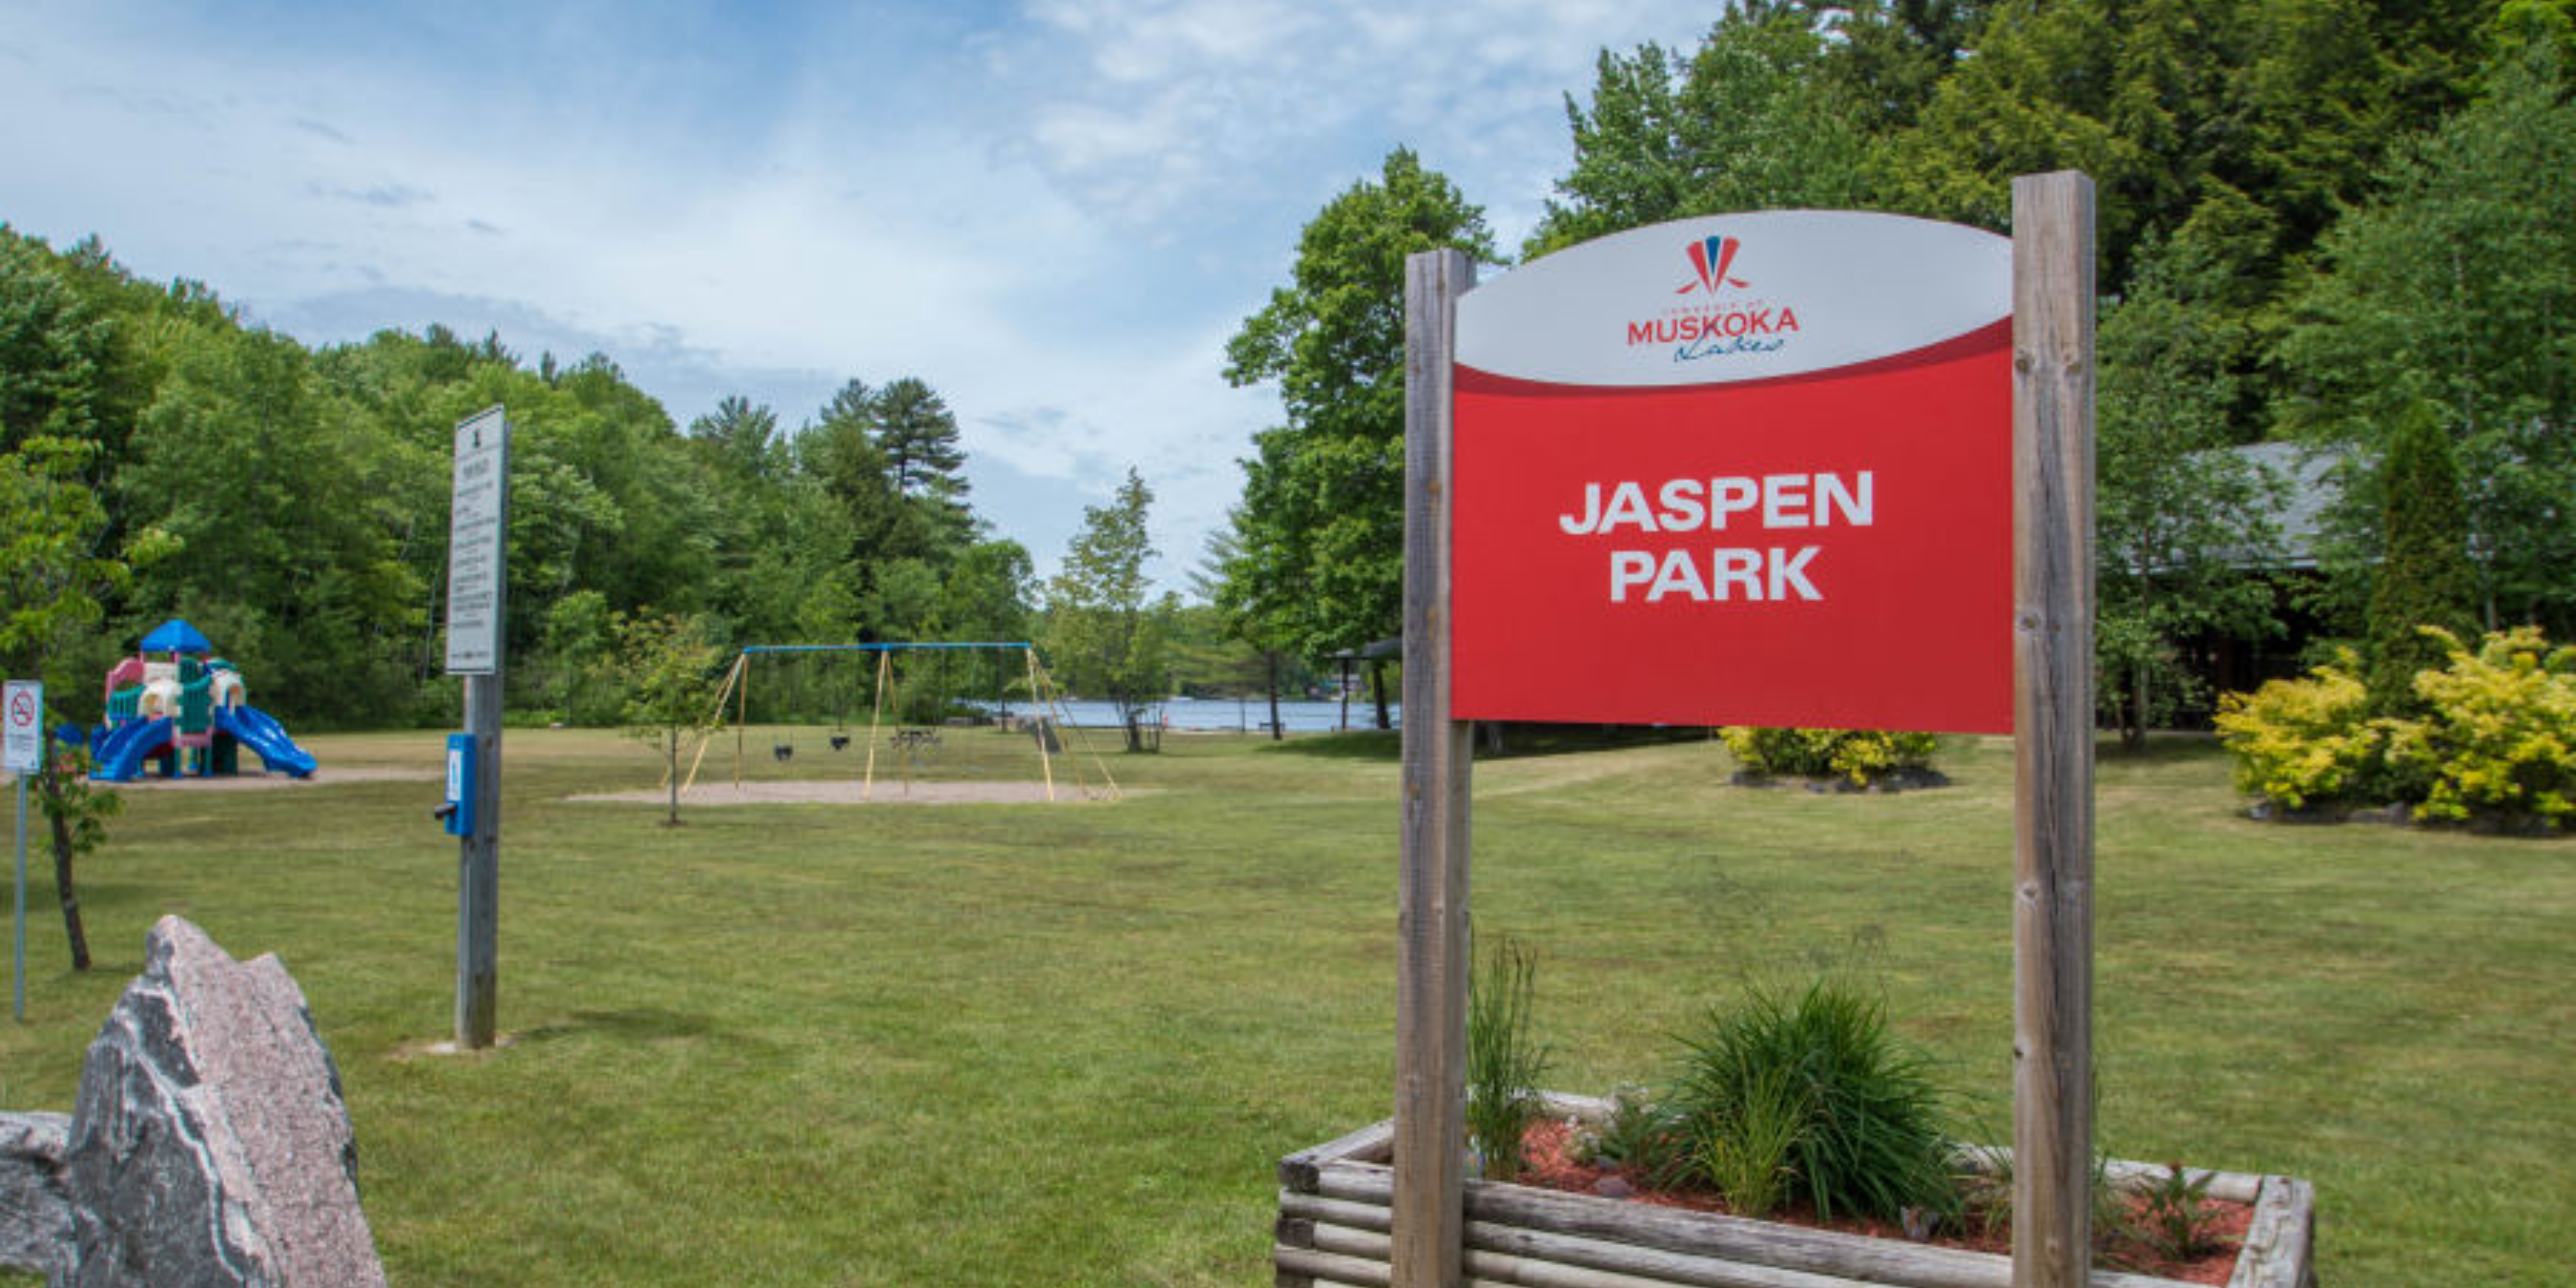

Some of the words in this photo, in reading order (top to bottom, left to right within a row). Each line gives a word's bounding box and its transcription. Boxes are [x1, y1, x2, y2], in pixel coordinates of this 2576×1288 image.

[1627, 306, 1799, 344] MUSKOKA
[1559, 471, 1873, 535] JASPEN
[1610, 546, 1823, 602] PARK
